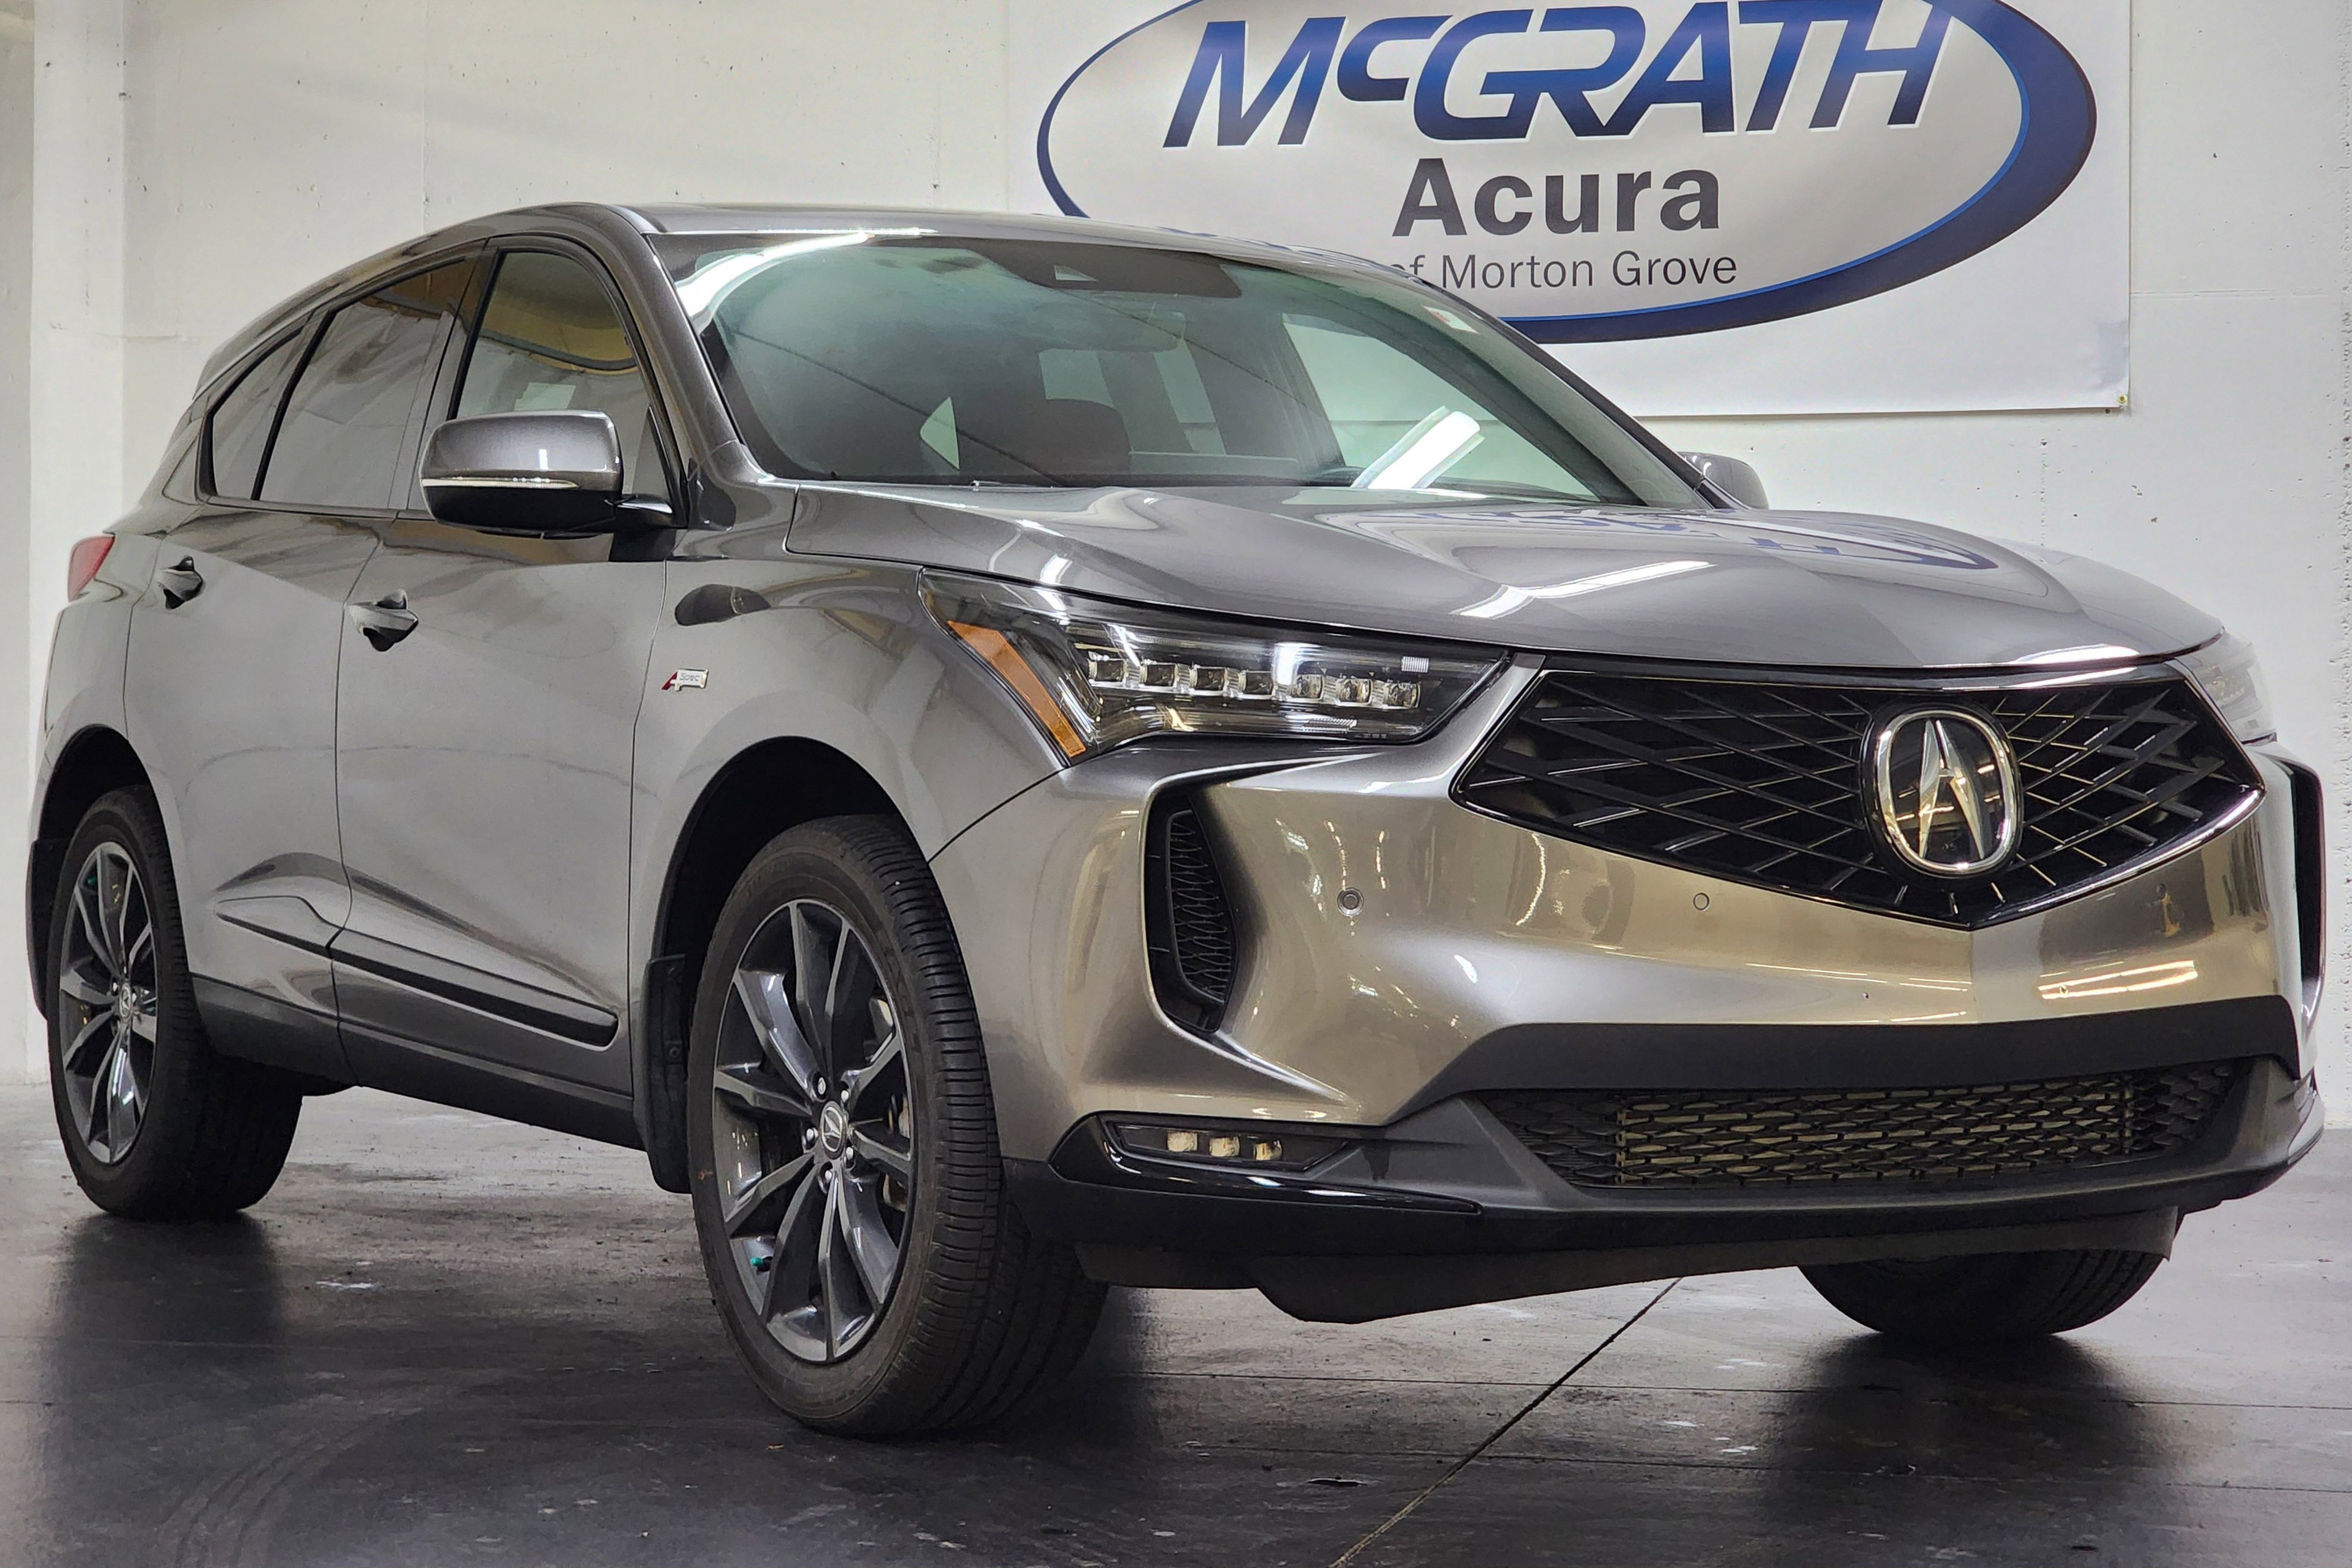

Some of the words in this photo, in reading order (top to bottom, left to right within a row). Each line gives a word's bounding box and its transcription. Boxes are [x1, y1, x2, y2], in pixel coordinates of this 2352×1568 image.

[1392, 157, 1720, 237] Acura
[1390, 254, 1426, 276] f
[1442, 253, 1594, 289] Morton
[1612, 250, 1737, 286] Grove
